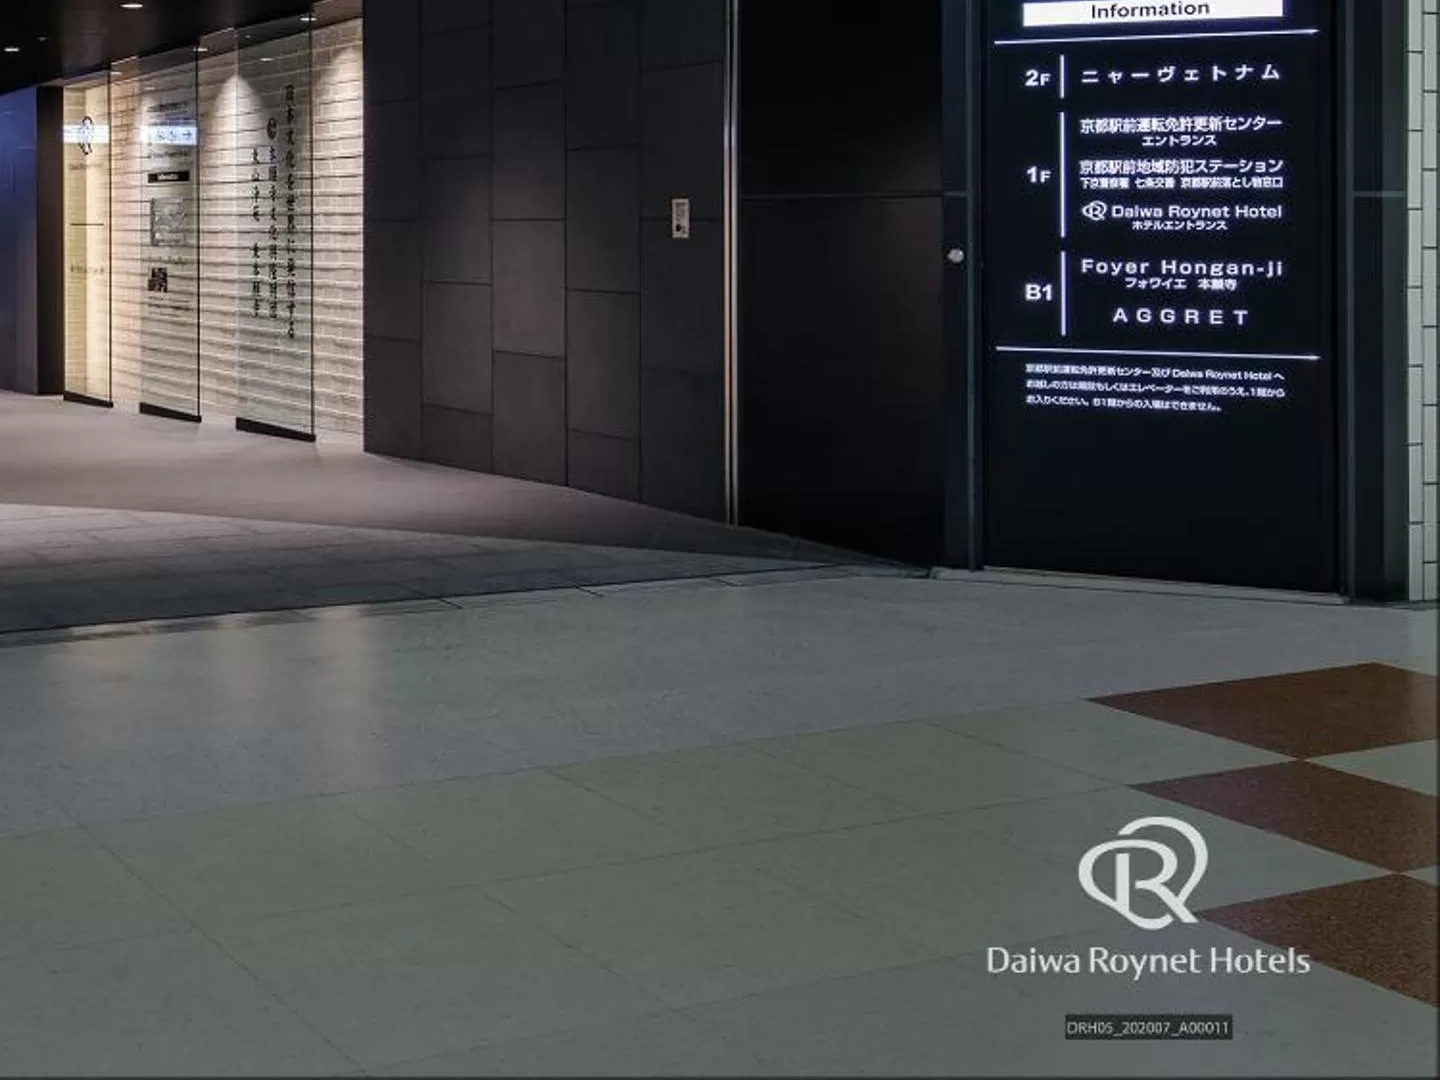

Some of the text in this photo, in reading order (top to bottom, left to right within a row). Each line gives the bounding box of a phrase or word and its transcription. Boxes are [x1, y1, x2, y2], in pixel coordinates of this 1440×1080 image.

[1092, 1, 1210, 19] Information
[1025, 69, 1051, 86] 2F
[1081, 65, 1280, 84] ニャーヴェトナム
[1142, 135, 1216, 146] エントランス
[1027, 167, 1051, 183] 1F
[1112, 205, 1162, 218] Daiwa
[1168, 205, 1229, 220] Roynet
[1236, 205, 1282, 218] Hotel
[1081, 258, 1282, 278] Foyer Hongan-ji
[1025, 284, 1052, 300] B1
[1125, 278, 1186, 290] フォワイエ
[1113, 308, 1248, 324] AGGRET
